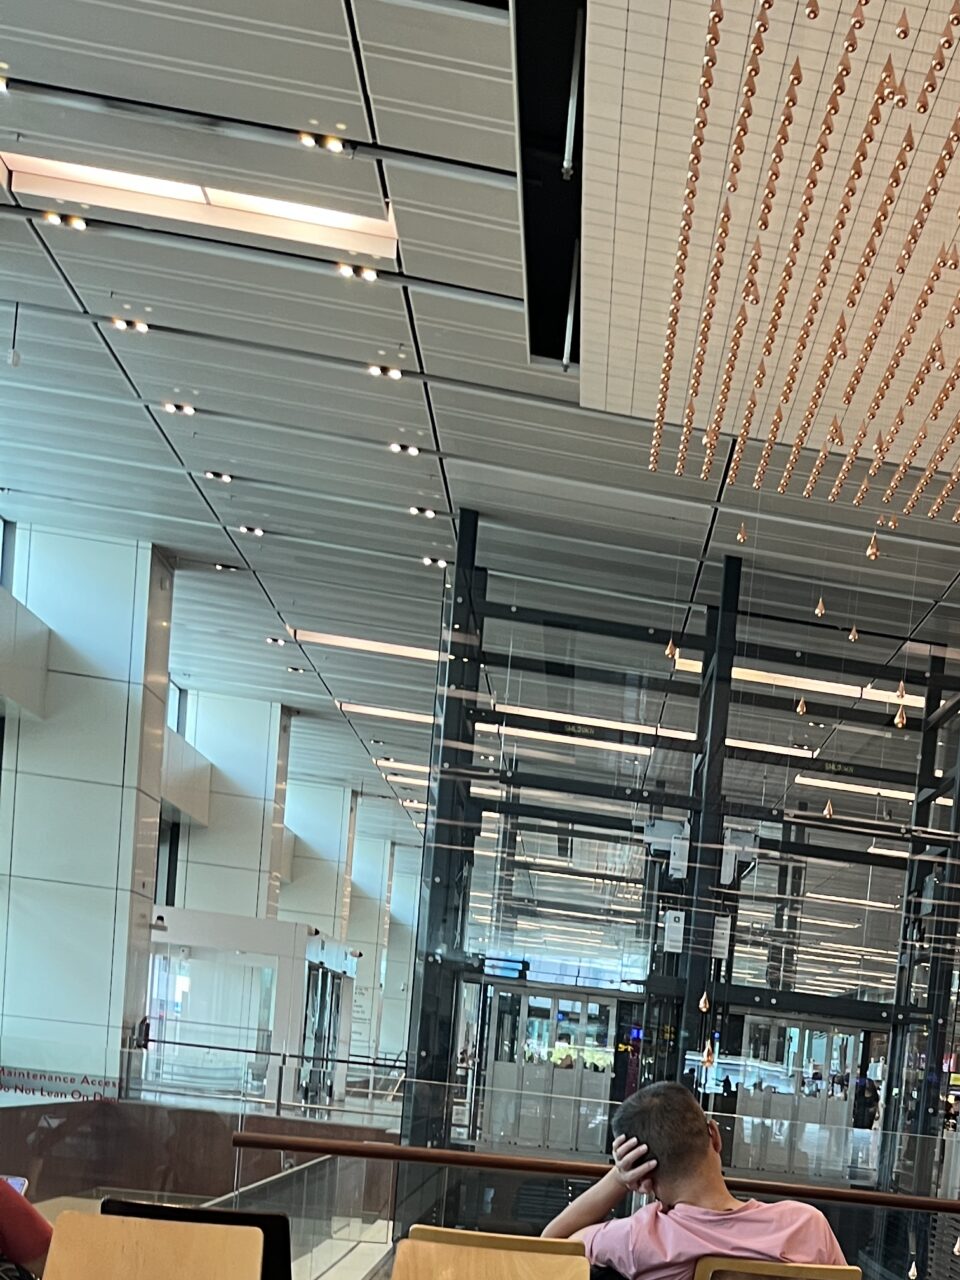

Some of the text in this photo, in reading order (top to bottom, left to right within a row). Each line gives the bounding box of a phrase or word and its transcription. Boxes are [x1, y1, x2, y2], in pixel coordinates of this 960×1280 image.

[14, 1083, 36, 1095] Not
[40, 1087, 67, 1099] Lean
[71, 1089, 89, 1102] On
